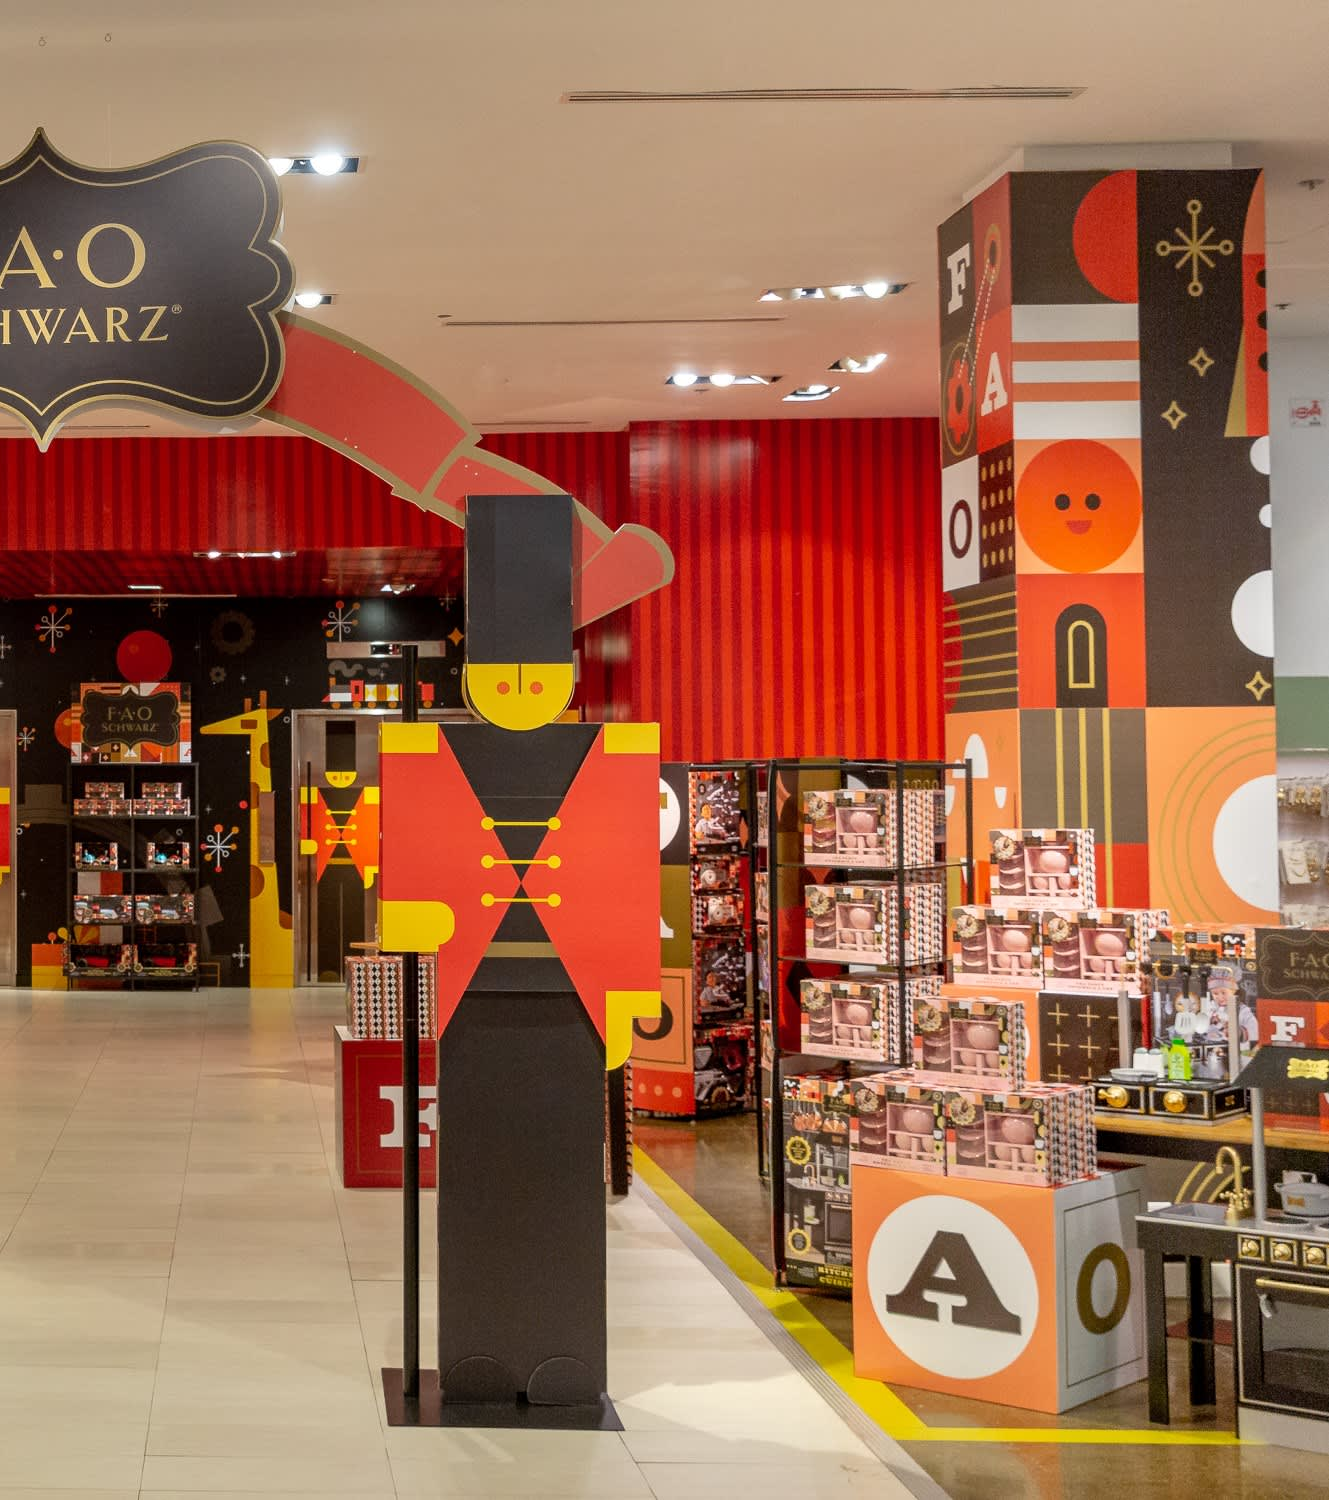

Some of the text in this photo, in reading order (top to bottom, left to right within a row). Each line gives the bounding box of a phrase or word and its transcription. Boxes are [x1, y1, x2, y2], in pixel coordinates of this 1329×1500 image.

[947, 243, 970, 315] F
[981, 352, 1008, 417] A
[1270, 1016, 1305, 1042] F
[379, 1086, 437, 1147] F
[886, 1230, 1022, 1335] A
